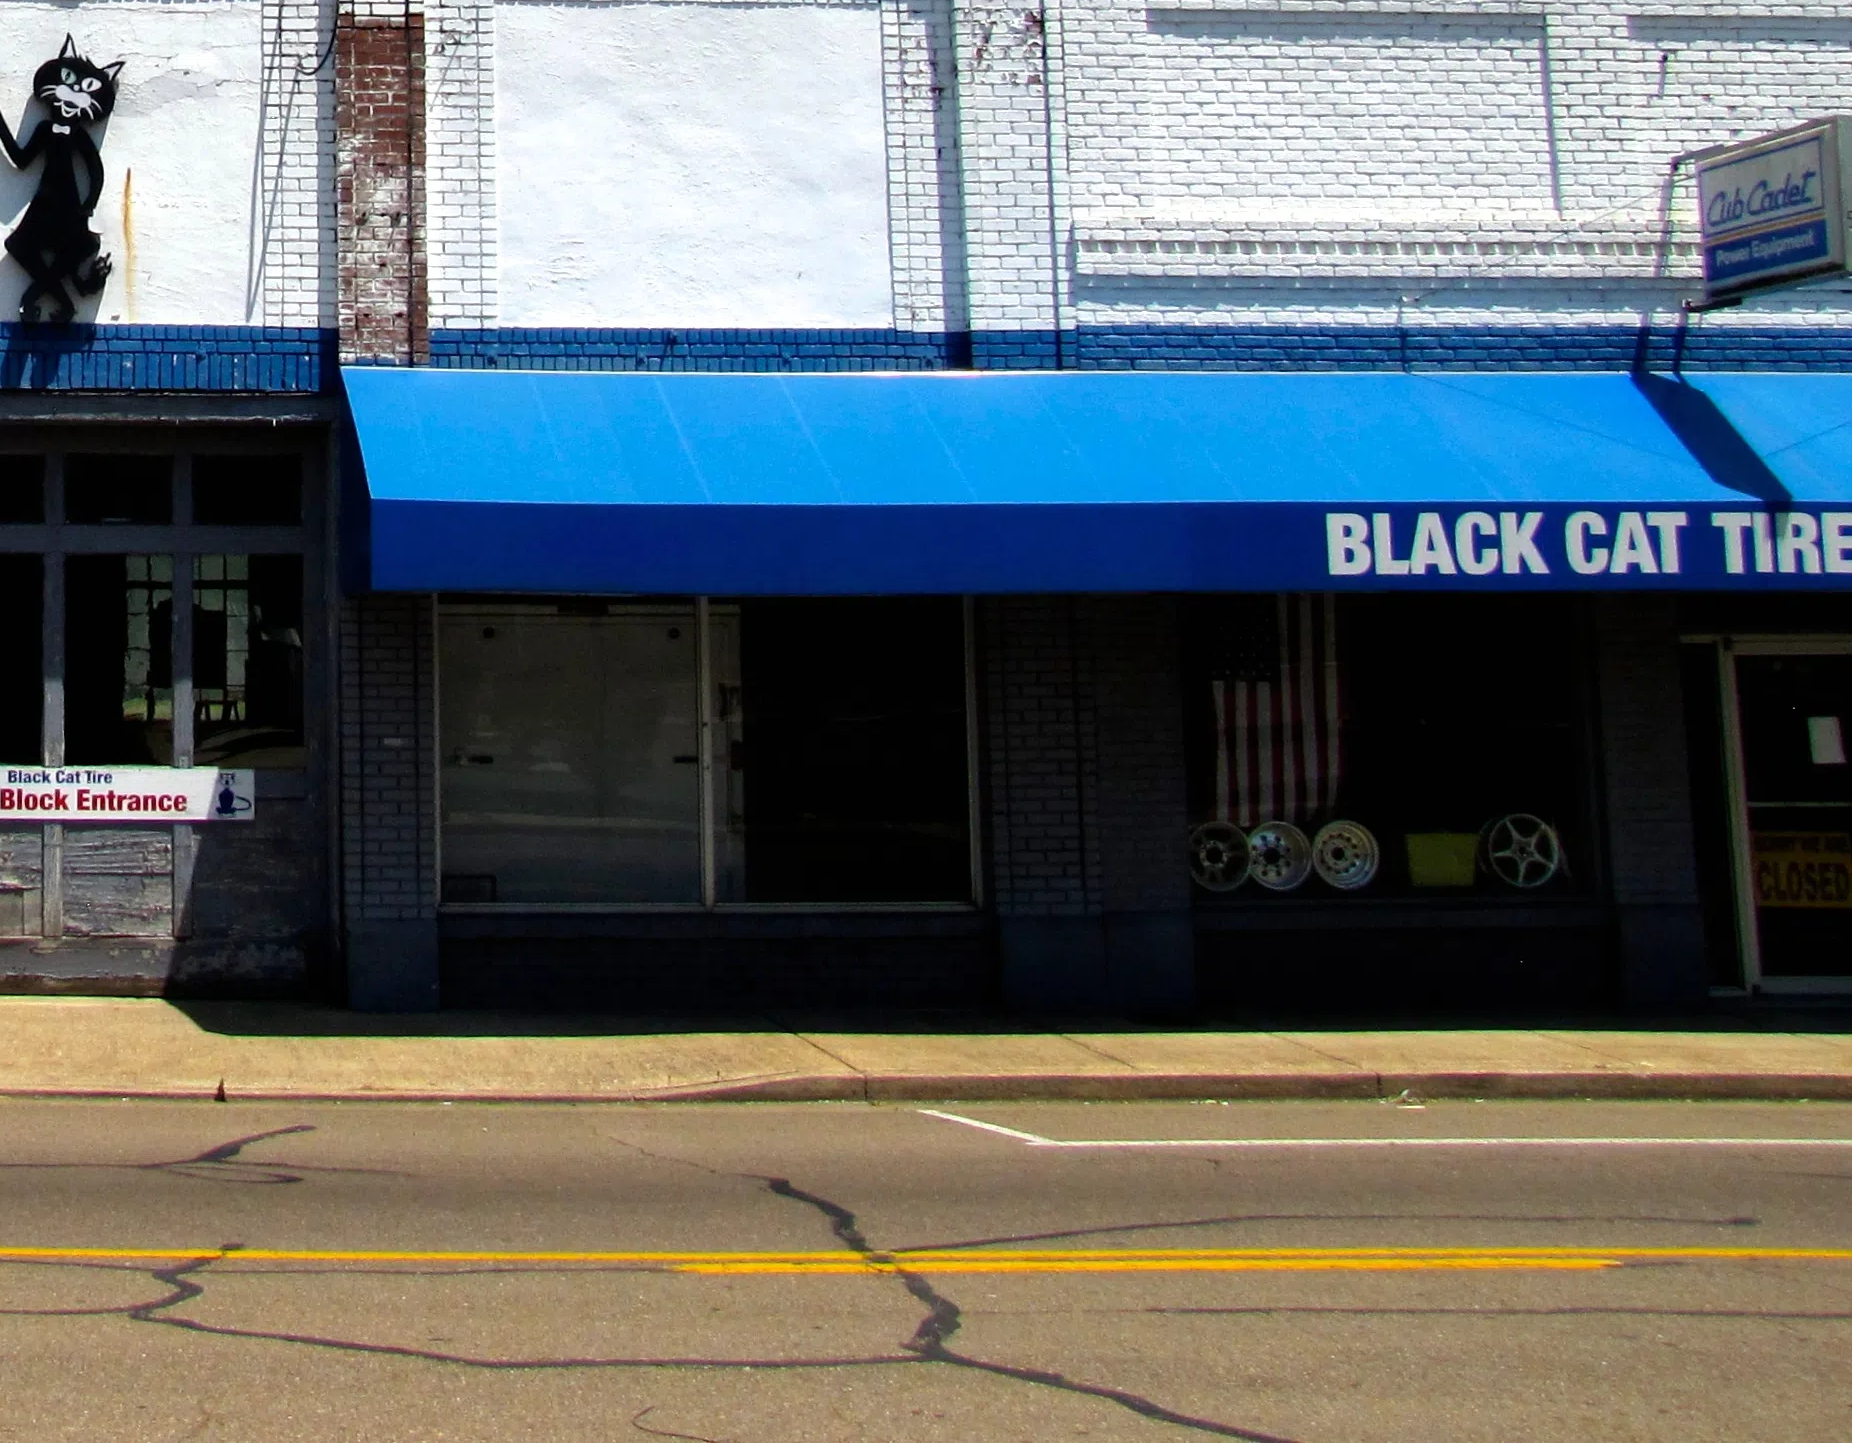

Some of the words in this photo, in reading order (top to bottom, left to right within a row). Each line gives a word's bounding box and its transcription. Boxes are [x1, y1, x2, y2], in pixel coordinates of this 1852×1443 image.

[1706, 187, 1745, 227] Cub
[1748, 170, 1817, 216] Cadet
[1325, 511, 1550, 576] BLACK
[1564, 510, 1688, 575] CAT
[1710, 511, 1852, 574] TIRE
[7, 770, 51, 784] Black
[55, 770, 80, 784] Cat
[85, 770, 113, 784] Tire
[0, 788, 70, 811] Block
[76, 789, 188, 812] Entrance
[1756, 860, 1849, 902] CLOSED
